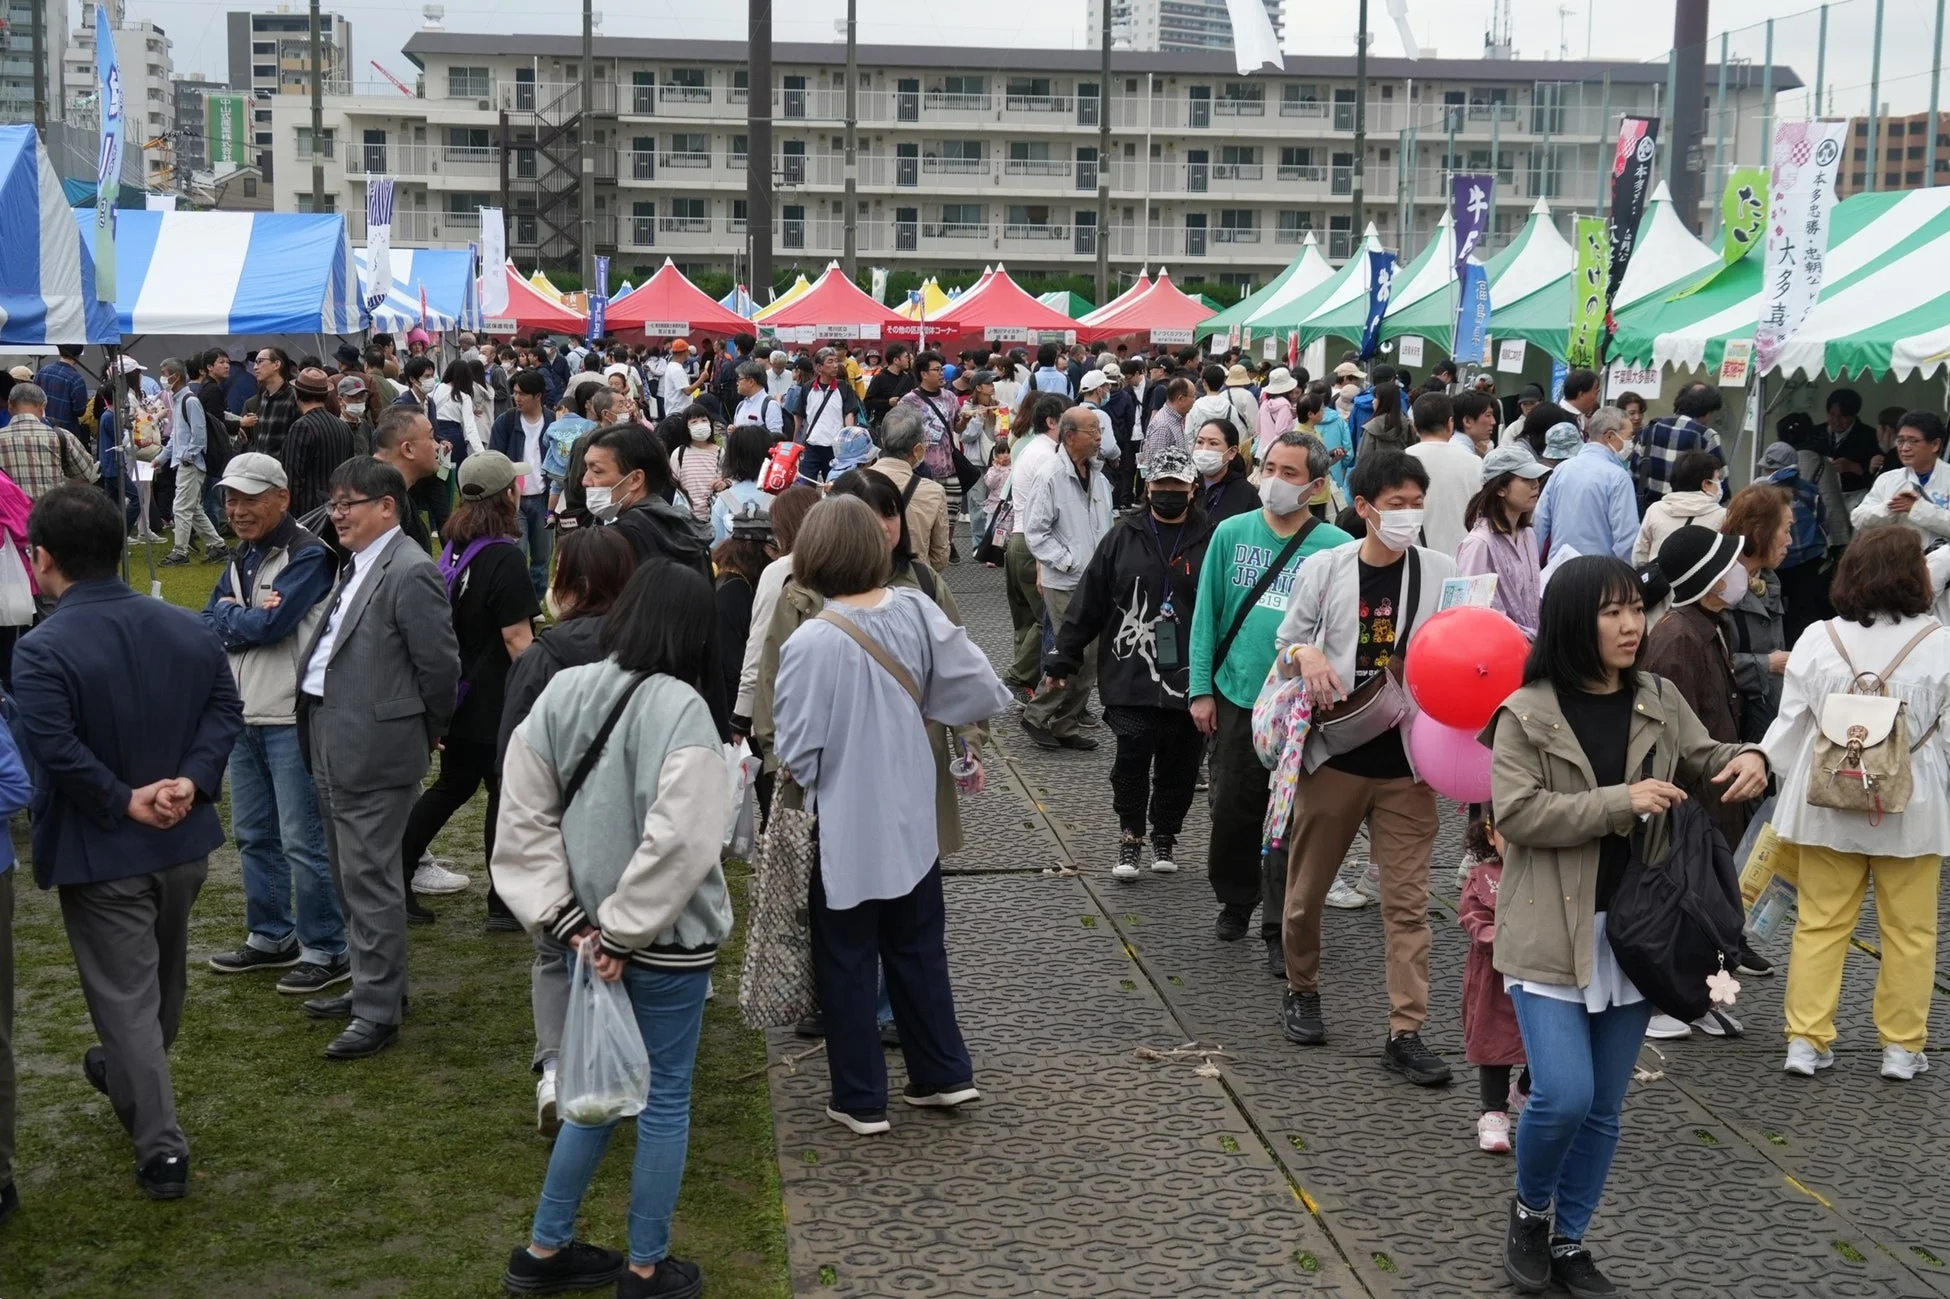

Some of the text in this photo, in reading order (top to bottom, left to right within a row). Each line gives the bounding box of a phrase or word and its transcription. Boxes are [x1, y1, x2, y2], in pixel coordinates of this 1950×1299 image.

[1804, 171, 1828, 300] 本多忠勝・忠朝公
[1613, 369, 1658, 385] 千葉県大多喜町
